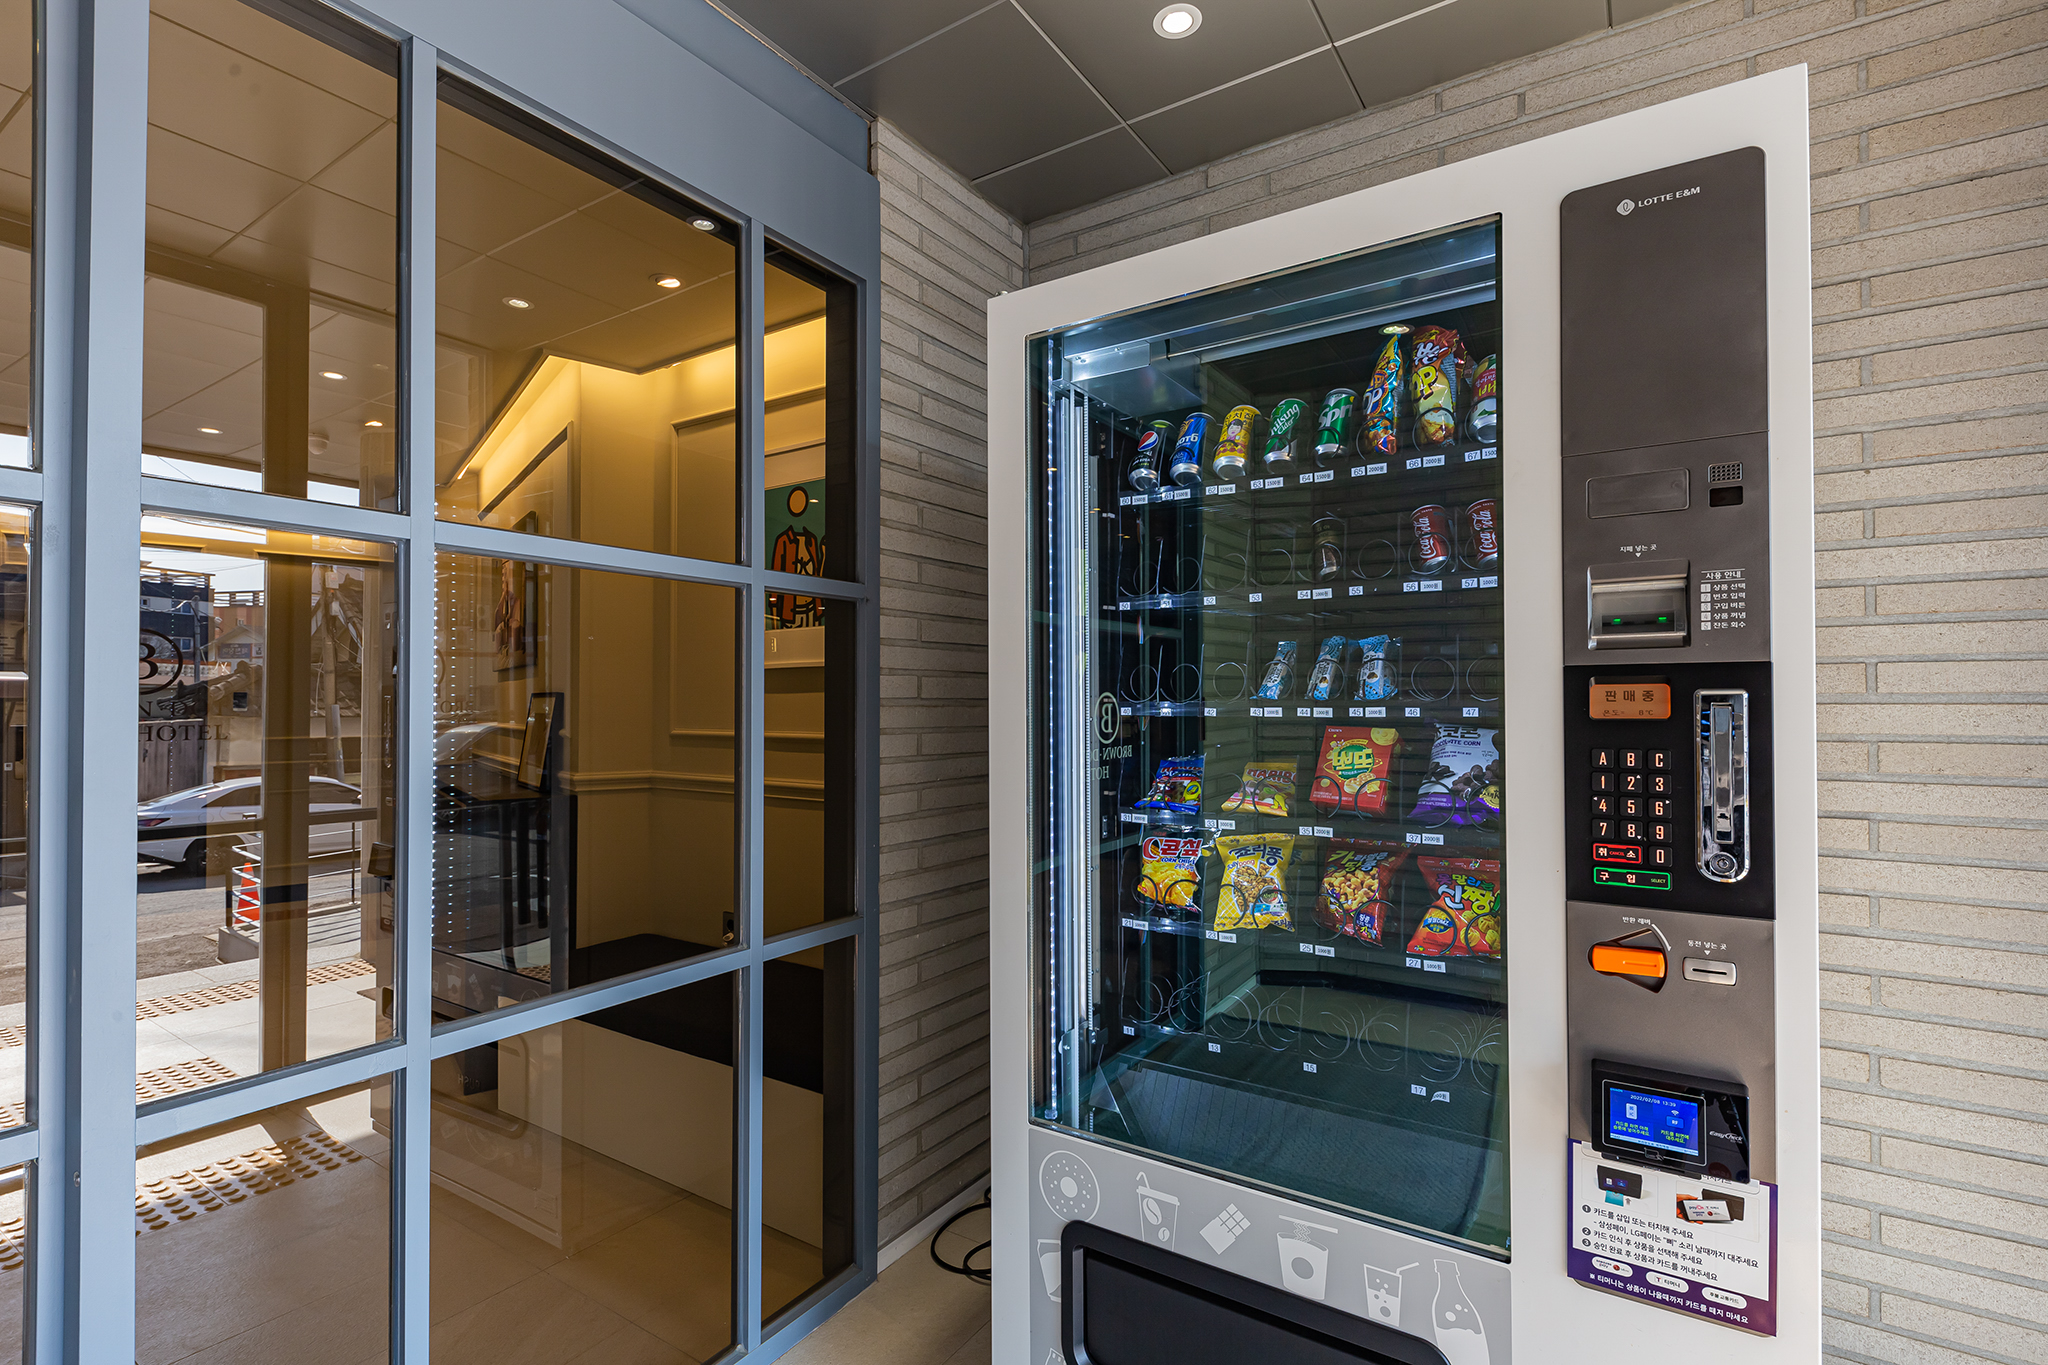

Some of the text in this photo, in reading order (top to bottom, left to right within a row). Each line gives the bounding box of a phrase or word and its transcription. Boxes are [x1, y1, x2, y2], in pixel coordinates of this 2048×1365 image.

[1638, 186, 1701, 207] LOTTE E&M
[1635, 544, 1648, 552] 넣는
[1650, 543, 1657, 551] 곳
[1705, 571, 1741, 580] 사용 안내
[1730, 601, 1746, 609] 버튼
[1713, 612, 1728, 620] 상품
[138, 724, 230, 742] HOTEL
[1332, 749, 1373, 771] 뽀또
[1599, 752, 1664, 767] A B C
[1601, 775, 1664, 791] 1 2 3
[1599, 799, 1664, 815] 4 5 6
[1599, 822, 1664, 840] 7 8 9
[1160, 837, 1203, 857] 콘칩
[1228, 843, 1284, 866] 죠리퐁
[1656, 849, 1665, 864] 0
[1437, 884, 1496, 915] 신짱
[1688, 940, 1701, 948] 동전
[1704, 941, 1718, 949] 넣는
[1593, 1207, 1694, 1239] 카드를 삽입 또는 터치해 주세요
[1593, 1230, 1607, 1240] 카드
[1609, 1234, 1623, 1245] 인식
[1633, 1241, 1655, 1253] 상품을
[1656, 1247, 1679, 1260] 선택해
[1680, 1253, 1703, 1265] 주세요
[1630, 1229, 1662, 1243] LG페이는
[1678, 1241, 1694, 1252] 소리
[1695, 1244, 1726, 1260] 날때까지
[1727, 1253, 1759, 1268] 대주세요
[1593, 1241, 1718, 1281] 승인 완료 후 상품과 카드를 꺼내주세요
[1597, 1274, 1625, 1289] 티머니는
[1626, 1283, 1647, 1295] 상품이
[1685, 1299, 1707, 1313] 카드를
[1726, 1311, 1749, 1324] 마세요
